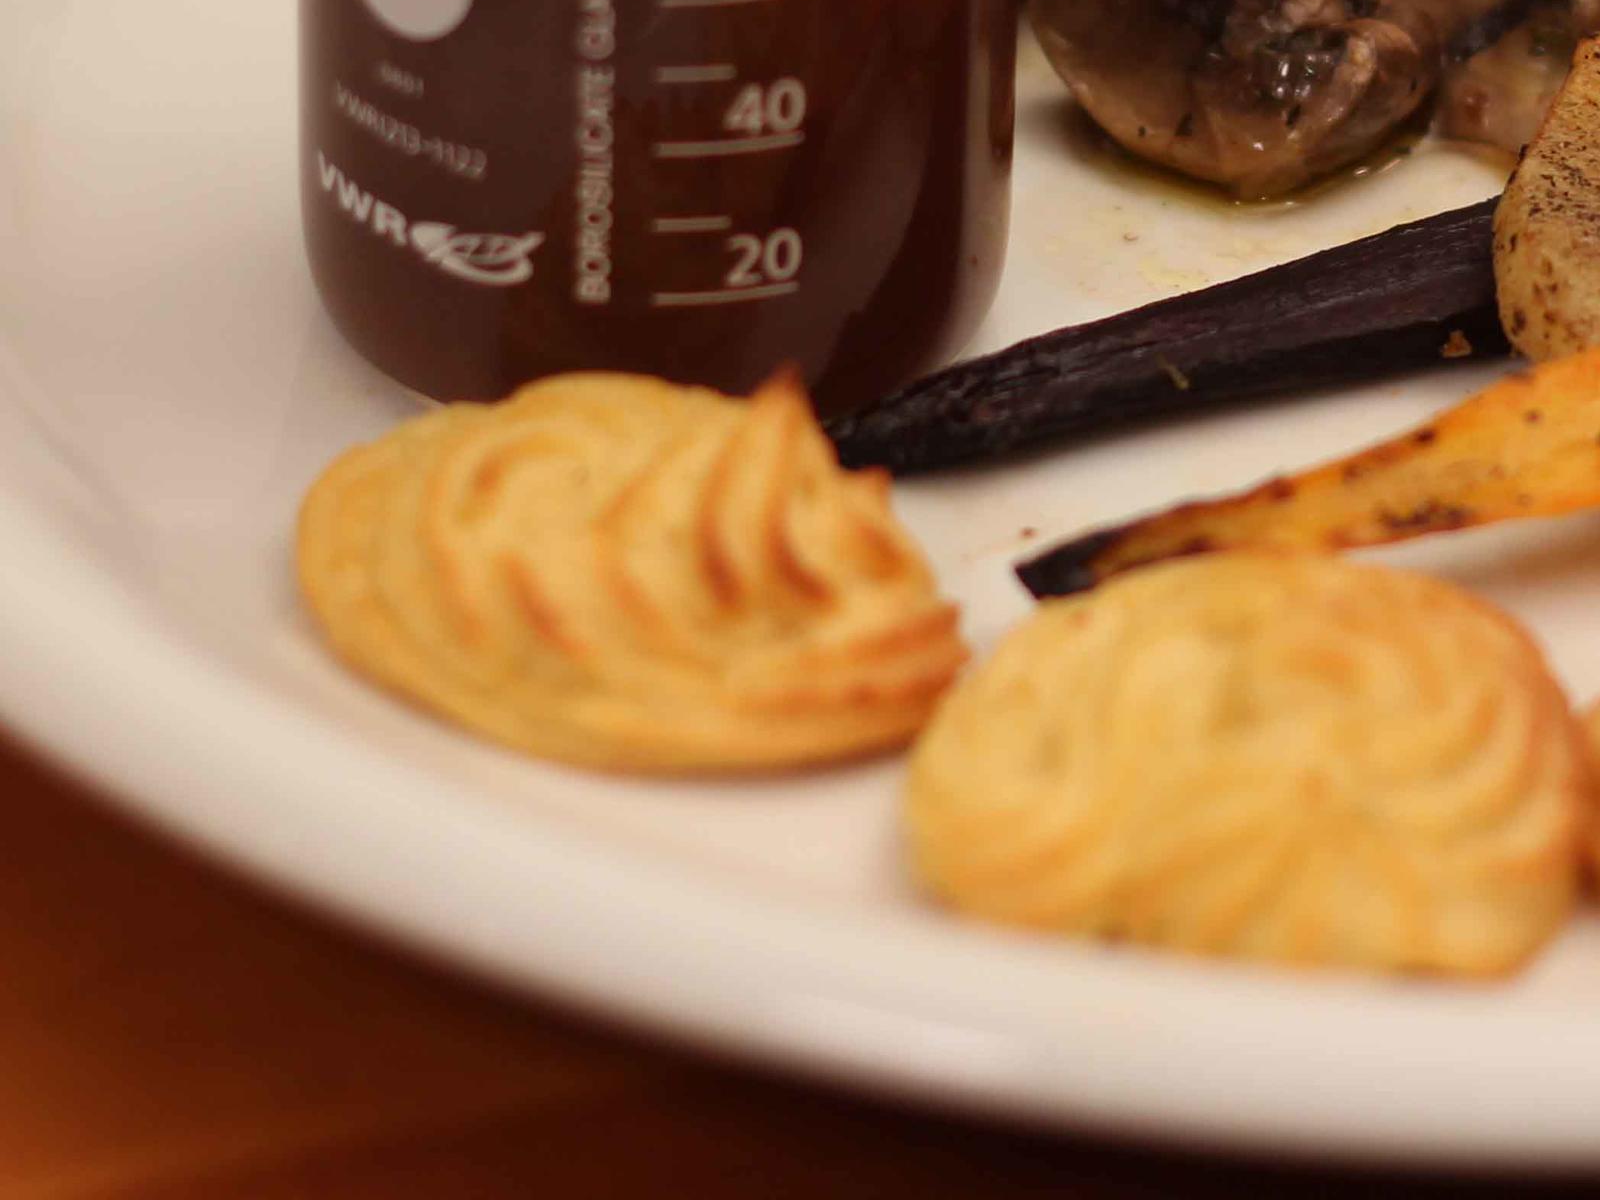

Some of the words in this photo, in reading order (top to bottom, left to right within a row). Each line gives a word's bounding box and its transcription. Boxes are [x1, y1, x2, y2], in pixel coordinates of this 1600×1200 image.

[723, 77, 807, 135] 40
[317, 149, 407, 246] VWR
[576, 65, 614, 304] BOROSILICATE
[725, 227, 803, 287] 20
